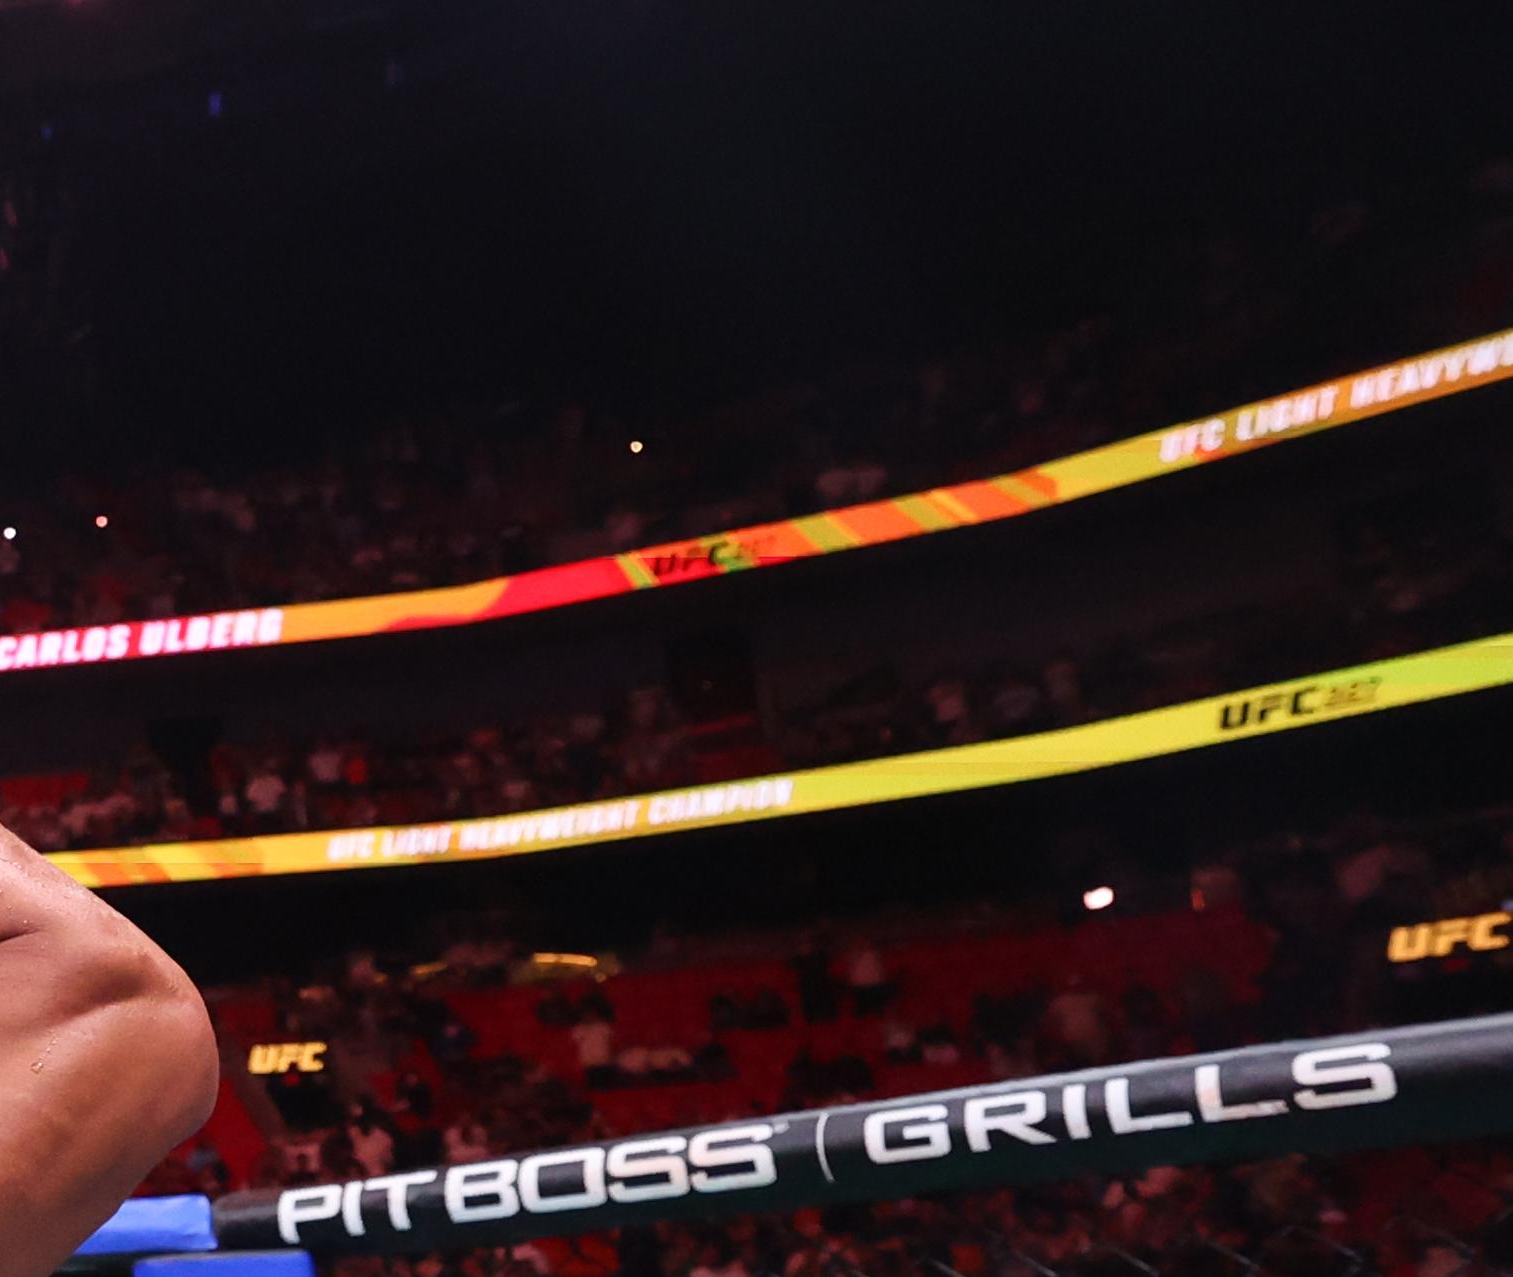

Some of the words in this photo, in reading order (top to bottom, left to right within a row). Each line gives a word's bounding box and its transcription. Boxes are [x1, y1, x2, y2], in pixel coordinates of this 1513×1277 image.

[1160, 419, 1226, 464] UFC
[1236, 386, 1340, 442] LIGHT
[139, 608, 283, 657] ULBERG
[1221, 686, 1319, 729] UFC
[381, 826, 452, 856] LIGHT
[458, 800, 642, 851] HEAVYWEIGHT
[647, 779, 793, 826] CHAMPION
[1388, 912, 1511, 963] UFC
[248, 1041, 328, 1074] UFC
[863, 1042, 1398, 1164] GRILLS
